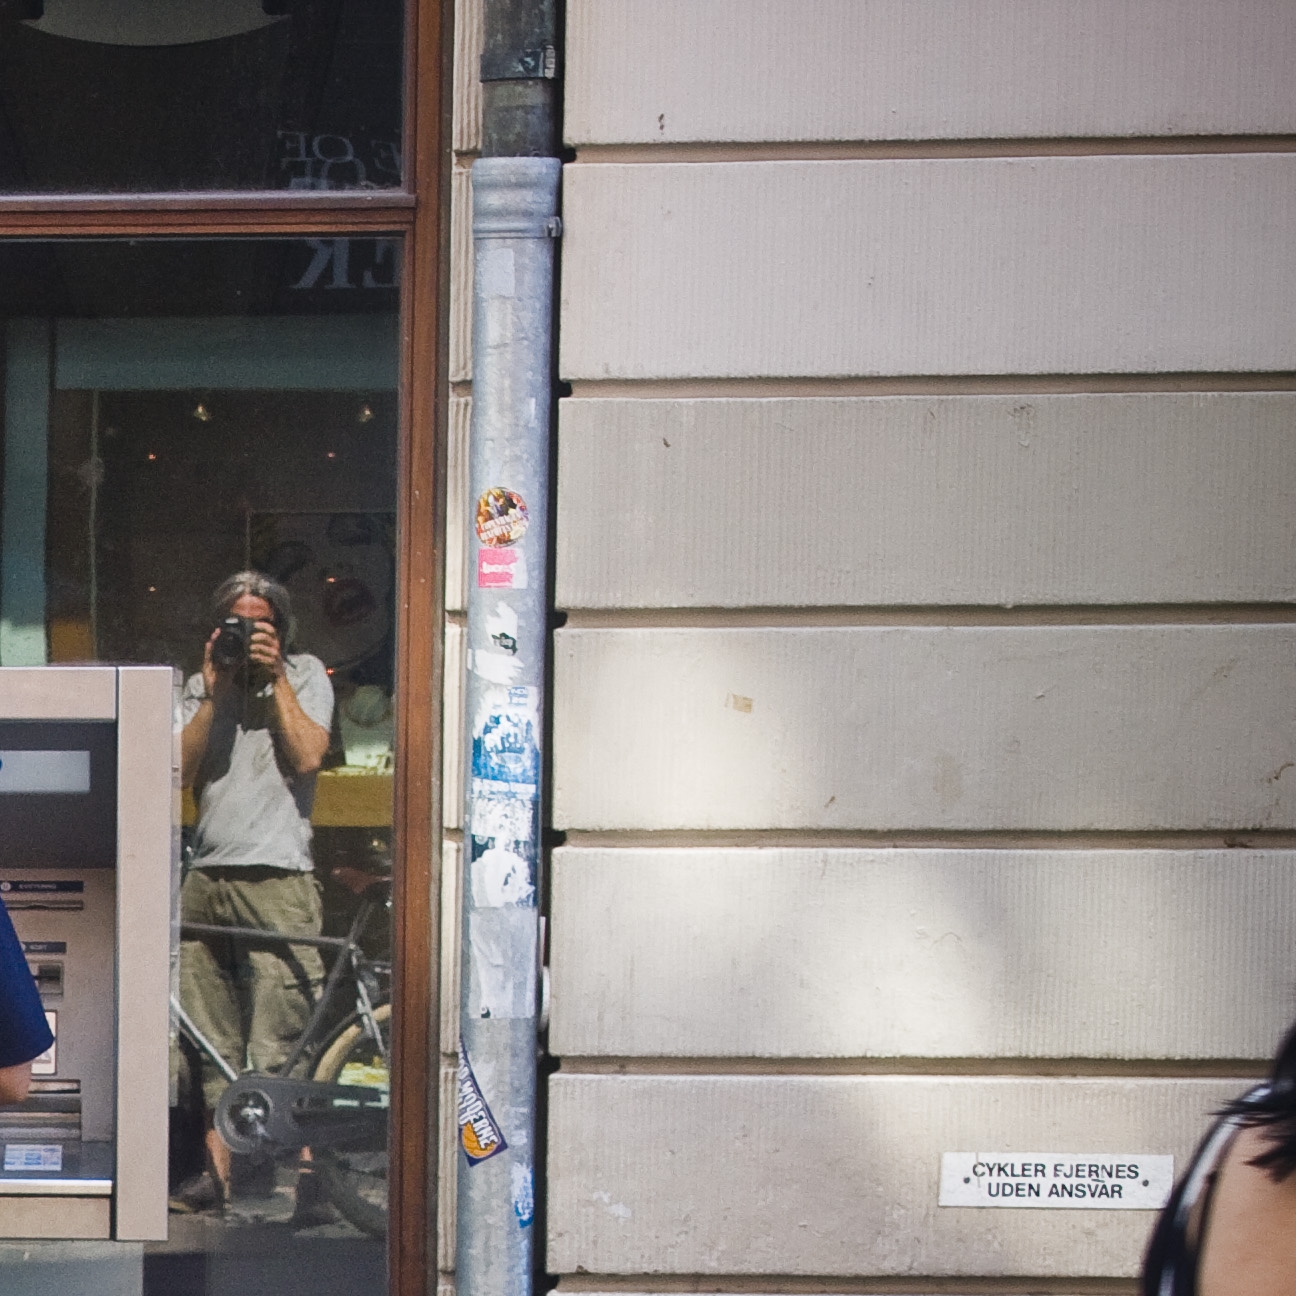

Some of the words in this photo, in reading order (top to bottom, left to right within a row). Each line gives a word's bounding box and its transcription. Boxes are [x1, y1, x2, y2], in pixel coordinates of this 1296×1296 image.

[972, 1162, 1046, 1178] CYKLER
[1054, 1163, 1140, 1180] FJERNES
[987, 1182, 1041, 1198] UDEN
[1047, 1183, 1124, 1199] ANSVAR
